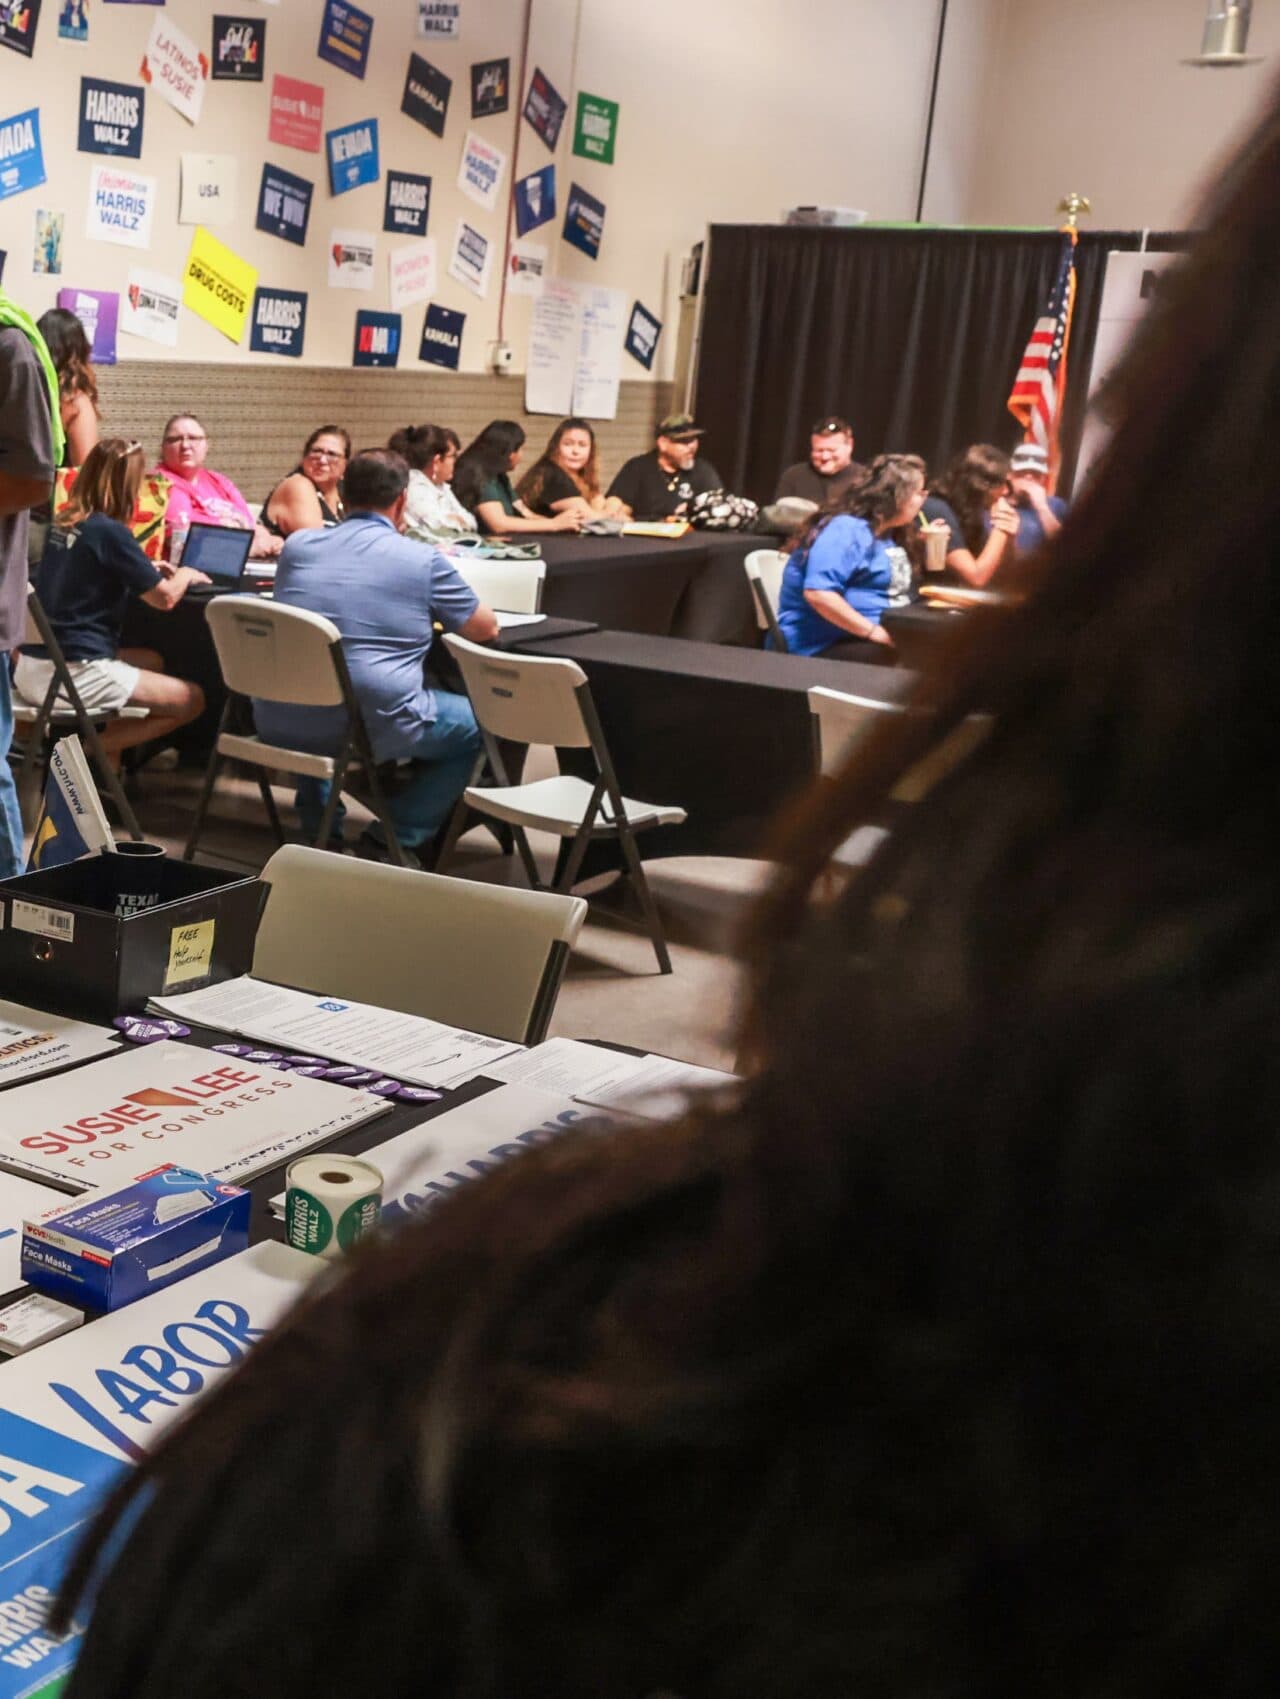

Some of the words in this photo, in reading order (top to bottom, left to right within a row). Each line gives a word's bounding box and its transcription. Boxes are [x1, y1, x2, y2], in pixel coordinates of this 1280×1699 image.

[419, 3, 459, 17] HARRIS
[424, 19, 453, 33] WALZ
[155, 33, 199, 81] LATINOS
[160, 66, 196, 100] SUSIE
[85, 89, 139, 128] HARRIS
[93, 124, 129, 147] WALZ
[96, 190, 146, 216] HARRIS
[198, 184, 220, 198] USA
[389, 180, 428, 210] HARRIS
[100, 209, 139, 231] WALZ
[394, 209, 420, 226] WALZ
[189, 263, 215, 292] DRUG
[215, 285, 246, 314] COSTS
[256, 298, 302, 329] HARRIS
[262, 326, 292, 345] WALZ
[177, 928, 200, 943] FREE
[21, 1098, 161, 1155] SUSIE
[172, 1066, 261, 1100] LEE
[68, 1141, 135, 1168] FOR
[141, 1079, 293, 1141] CONGRESS
[291, 1196, 309, 1249] HARRIS
[308, 1209, 320, 1243] WALZ
[361, 1201, 377, 1231] RIS
[23, 1245, 44, 1260] Face
[44, 1254, 73, 1273] Masks
[1, 1619, 87, 1669] WA
